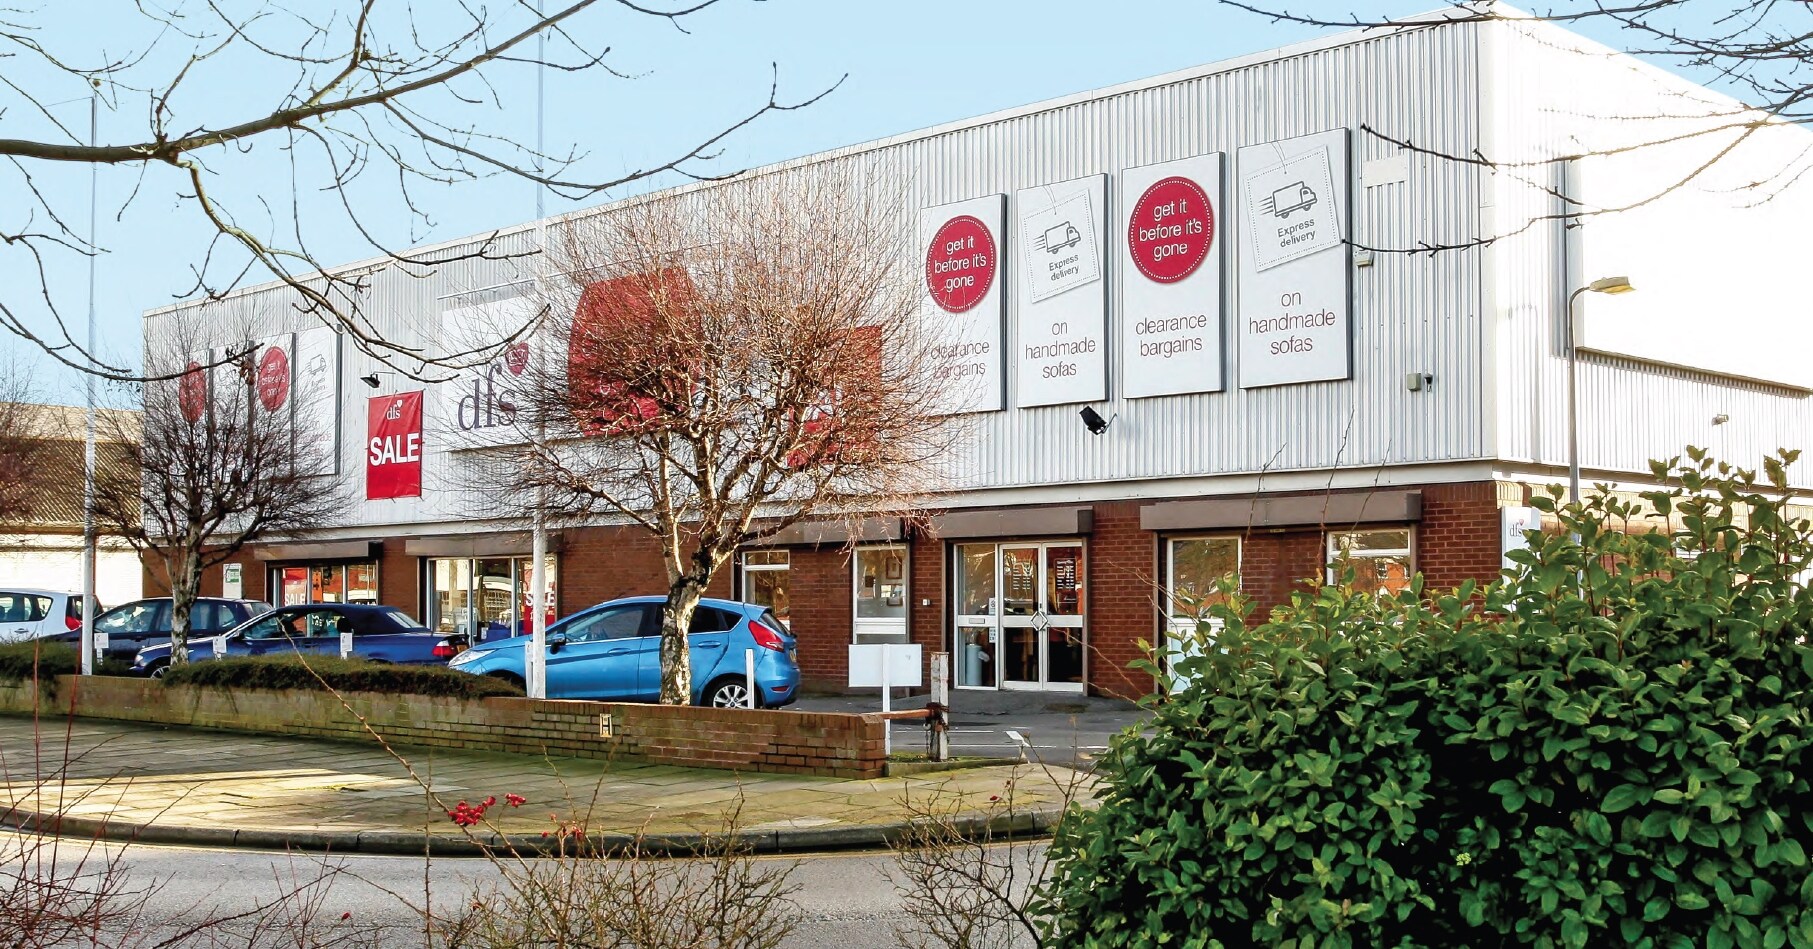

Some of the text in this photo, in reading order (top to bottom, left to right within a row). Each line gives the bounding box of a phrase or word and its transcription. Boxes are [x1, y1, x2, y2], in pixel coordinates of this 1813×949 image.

[1153, 199, 1187, 221] get it
[1139, 219, 1203, 242] before it's
[1277, 218, 1315, 238] Express
[946, 235, 975, 255] get it
[1279, 230, 1316, 248] delivery
[1153, 243, 1188, 262] gone
[934, 253, 987, 274] before it's
[1048, 254, 1079, 271] Express
[1050, 265, 1080, 281] delivery
[945, 275, 975, 292] gone
[1281, 291, 1302, 307] on
[1051, 321, 1068, 336] on
[1135, 314, 1208, 335] clearance
[1249, 308, 1336, 335] handmade
[930, 341, 990, 360] clearance
[1025, 337, 1096, 360] handmade
[1140, 336, 1203, 359] bargains
[1270, 335, 1314, 355] sofas
[1042, 361, 1077, 379] sofas
[458, 363, 516, 431] dfs
[386, 404, 401, 420] dfs
[369, 432, 420, 466] SALE
[1510, 522, 1522, 537] dfs
[284, 592, 305, 606] SALE
[525, 590, 555, 607] SE
